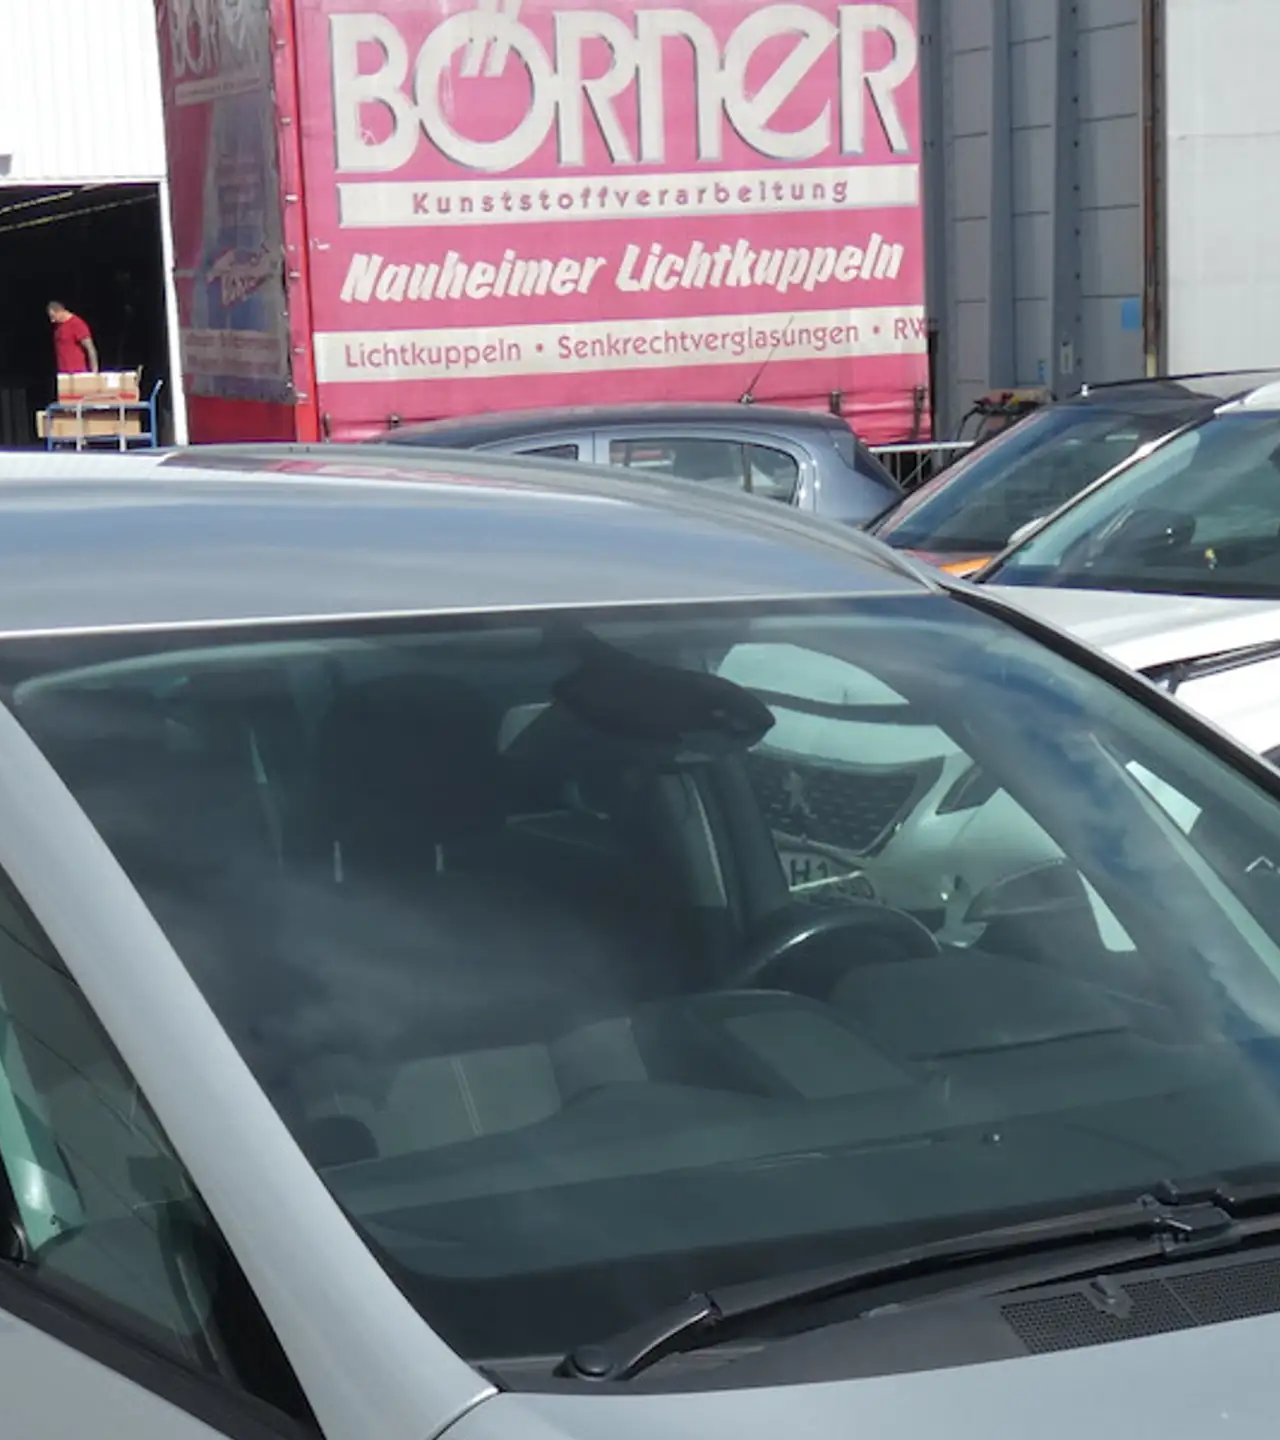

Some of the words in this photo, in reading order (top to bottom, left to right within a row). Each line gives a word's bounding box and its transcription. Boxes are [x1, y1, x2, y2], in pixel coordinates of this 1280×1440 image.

[412, 179, 849, 214] Kunststoffverarbeitung
[340, 249, 607, 302] Nauheimer
[615, 232, 904, 292] Lichtkuppeln
[345, 338, 521, 369] Lichtkuppeln
[558, 323, 859, 359] Senkrechtverglasungen
